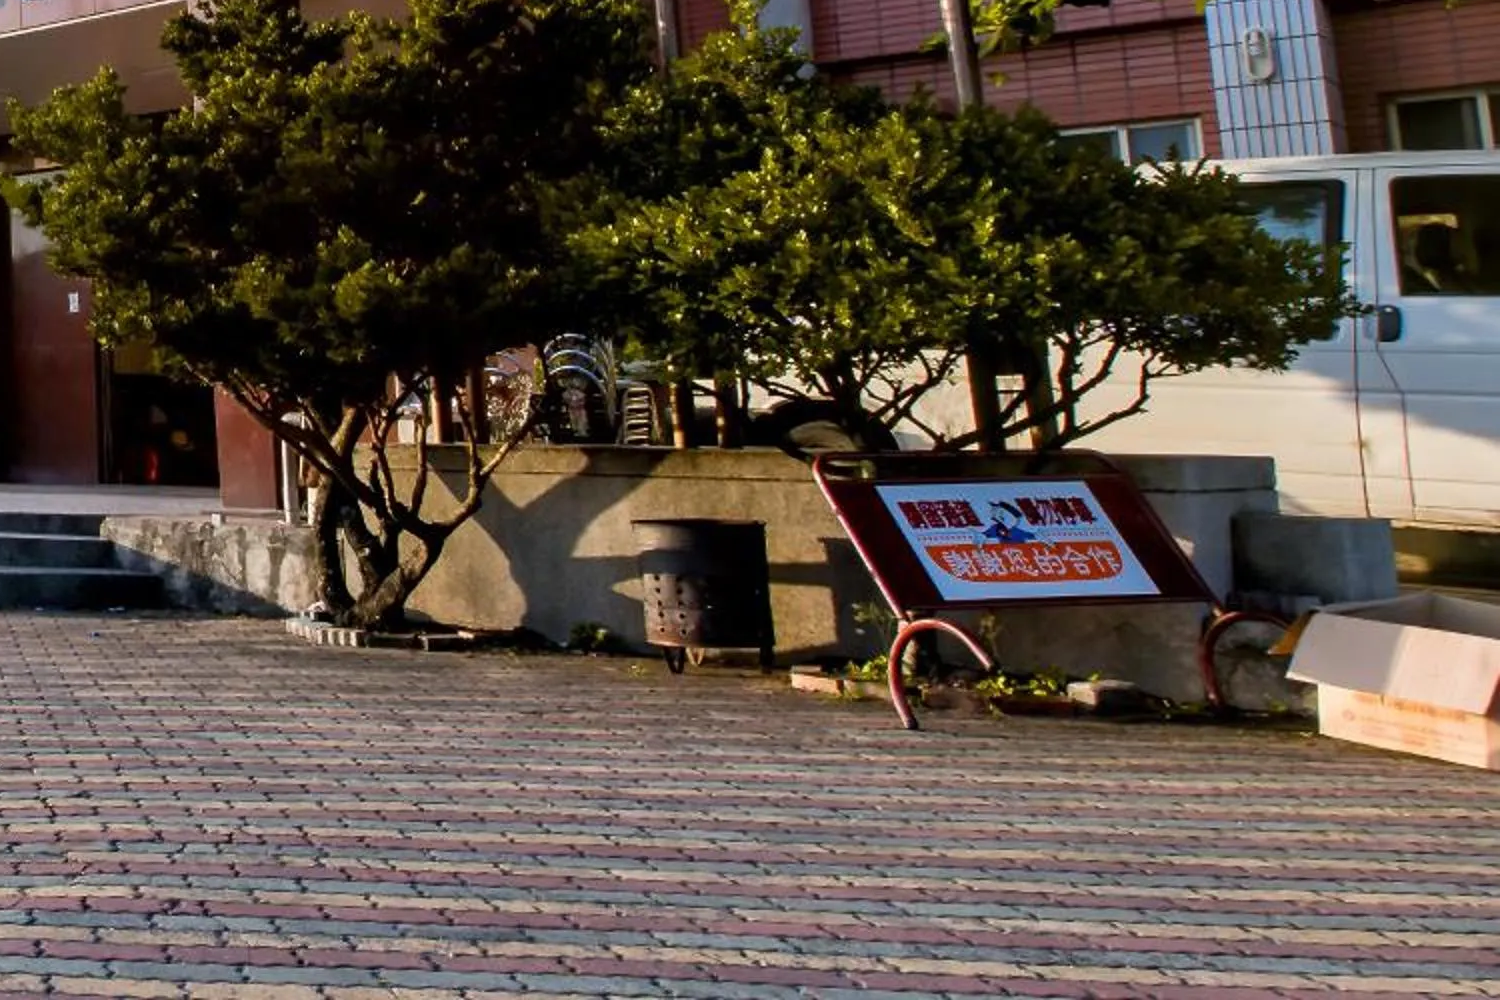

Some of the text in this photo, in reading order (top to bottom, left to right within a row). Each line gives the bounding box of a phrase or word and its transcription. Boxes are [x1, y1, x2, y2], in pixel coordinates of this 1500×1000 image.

[942, 547, 1122, 578] 謝謝您的合作
